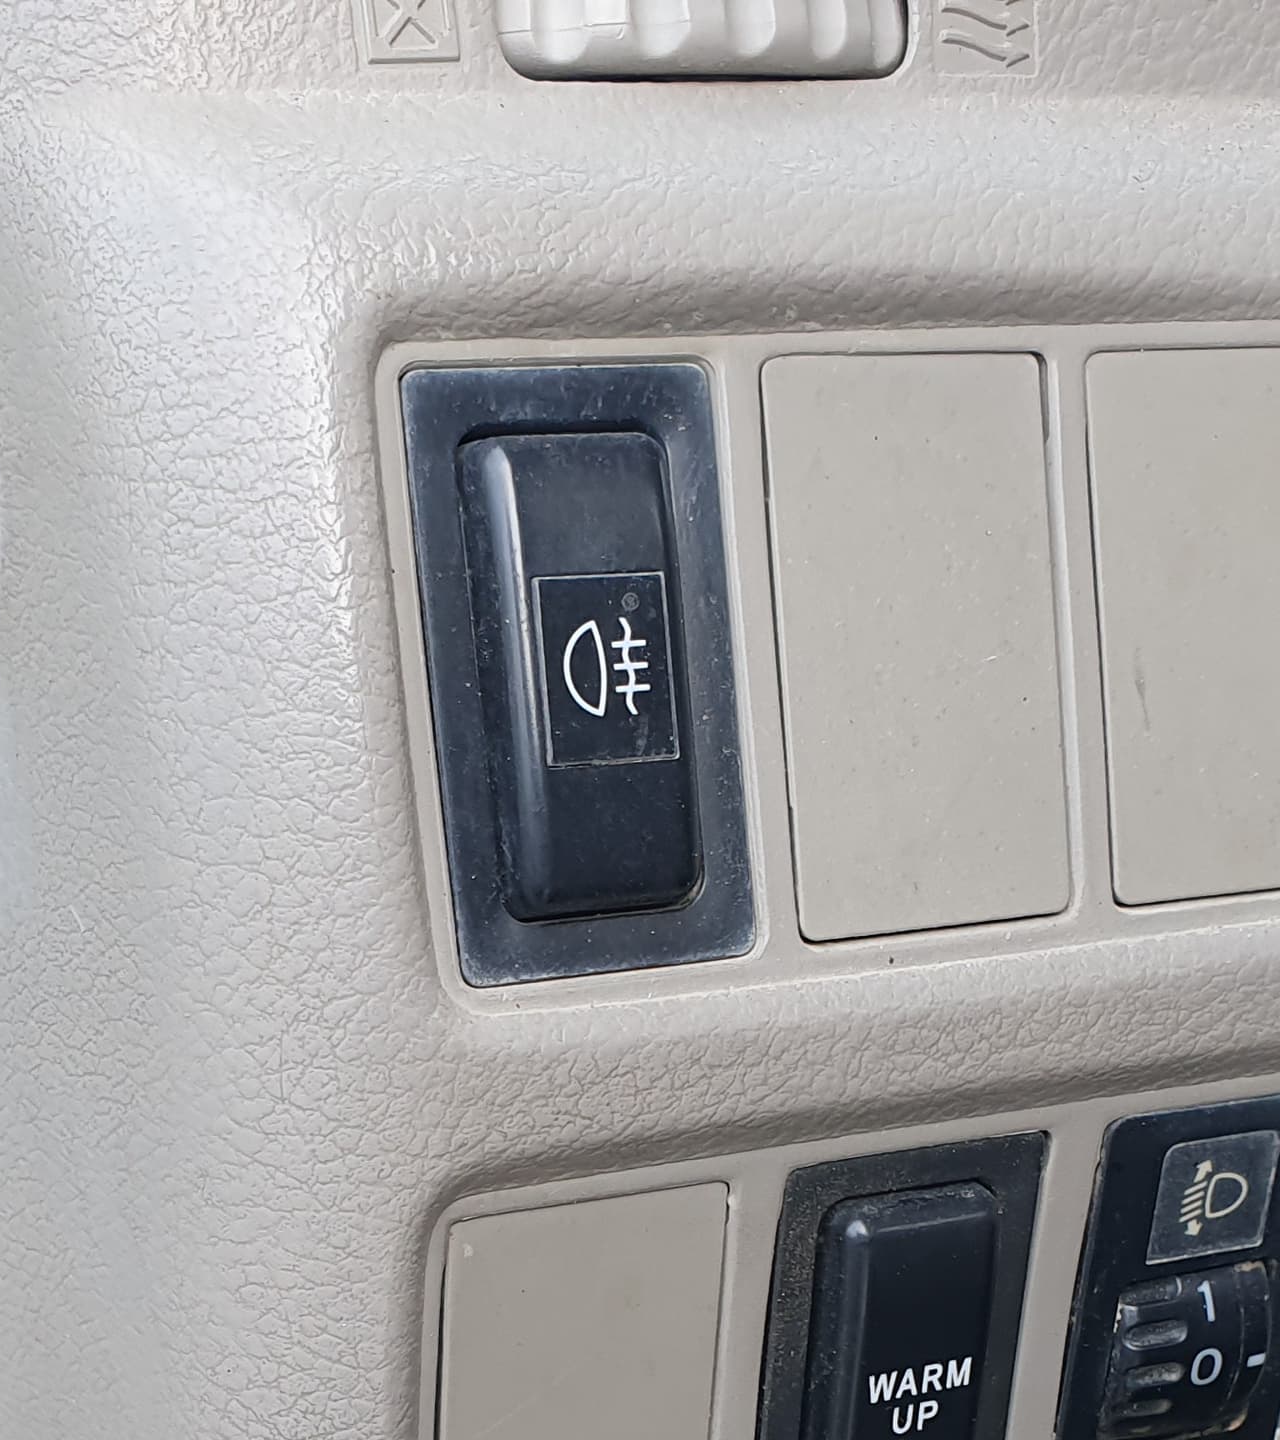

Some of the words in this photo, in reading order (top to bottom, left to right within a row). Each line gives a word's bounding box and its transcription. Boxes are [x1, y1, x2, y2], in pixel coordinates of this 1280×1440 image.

[1197, 1280, 1216, 1322] 1
[868, 1356, 973, 1404] WARM
[1190, 1347, 1223, 1386] 0
[892, 1400, 939, 1435] UP
